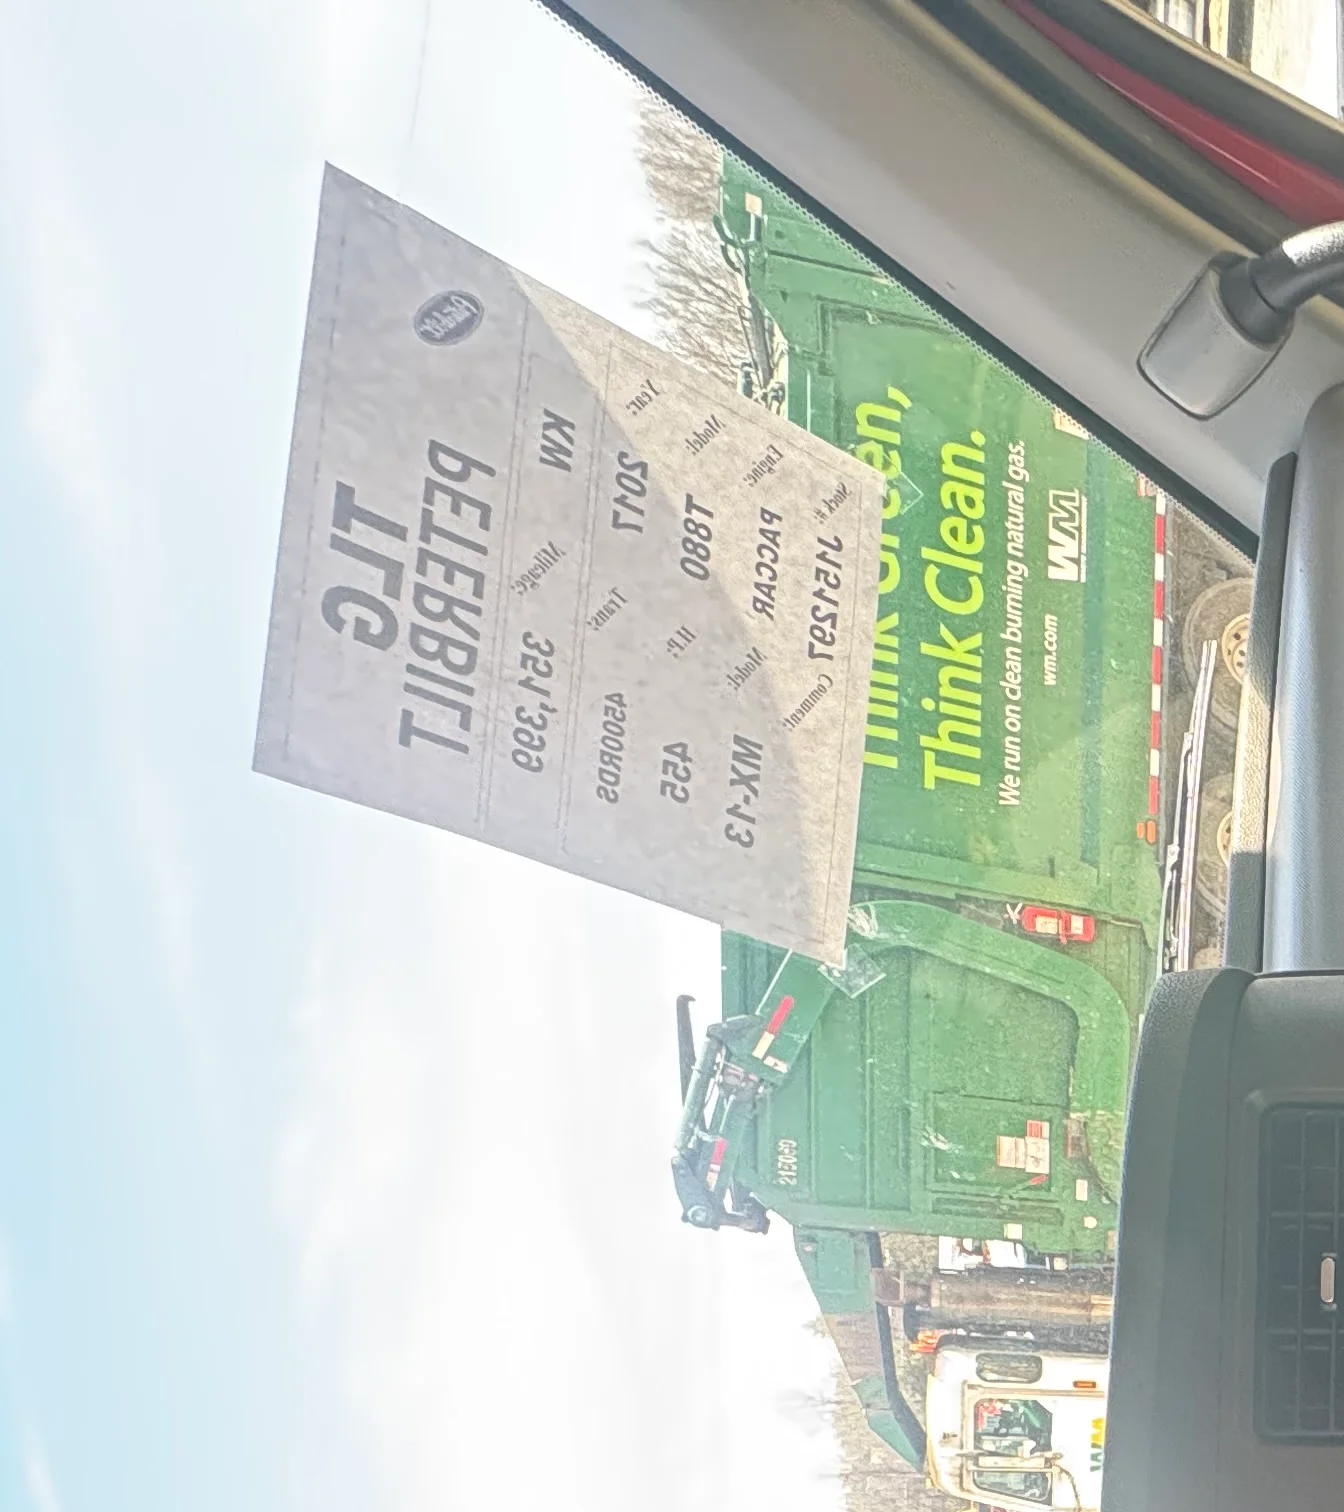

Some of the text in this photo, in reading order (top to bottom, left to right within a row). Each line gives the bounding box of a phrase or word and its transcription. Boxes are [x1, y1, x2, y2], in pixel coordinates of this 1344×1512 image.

[1007, 440, 1029, 483] gas.
[1002, 485, 1025, 558] natural
[919, 429, 986, 789] Think Clean.
[1044, 489, 1080, 686] wm.com WM
[1000, 647, 1022, 700] clean
[1005, 706, 1021, 731] on
[1004, 736, 1021, 770] run
[999, 775, 1021, 806] We
